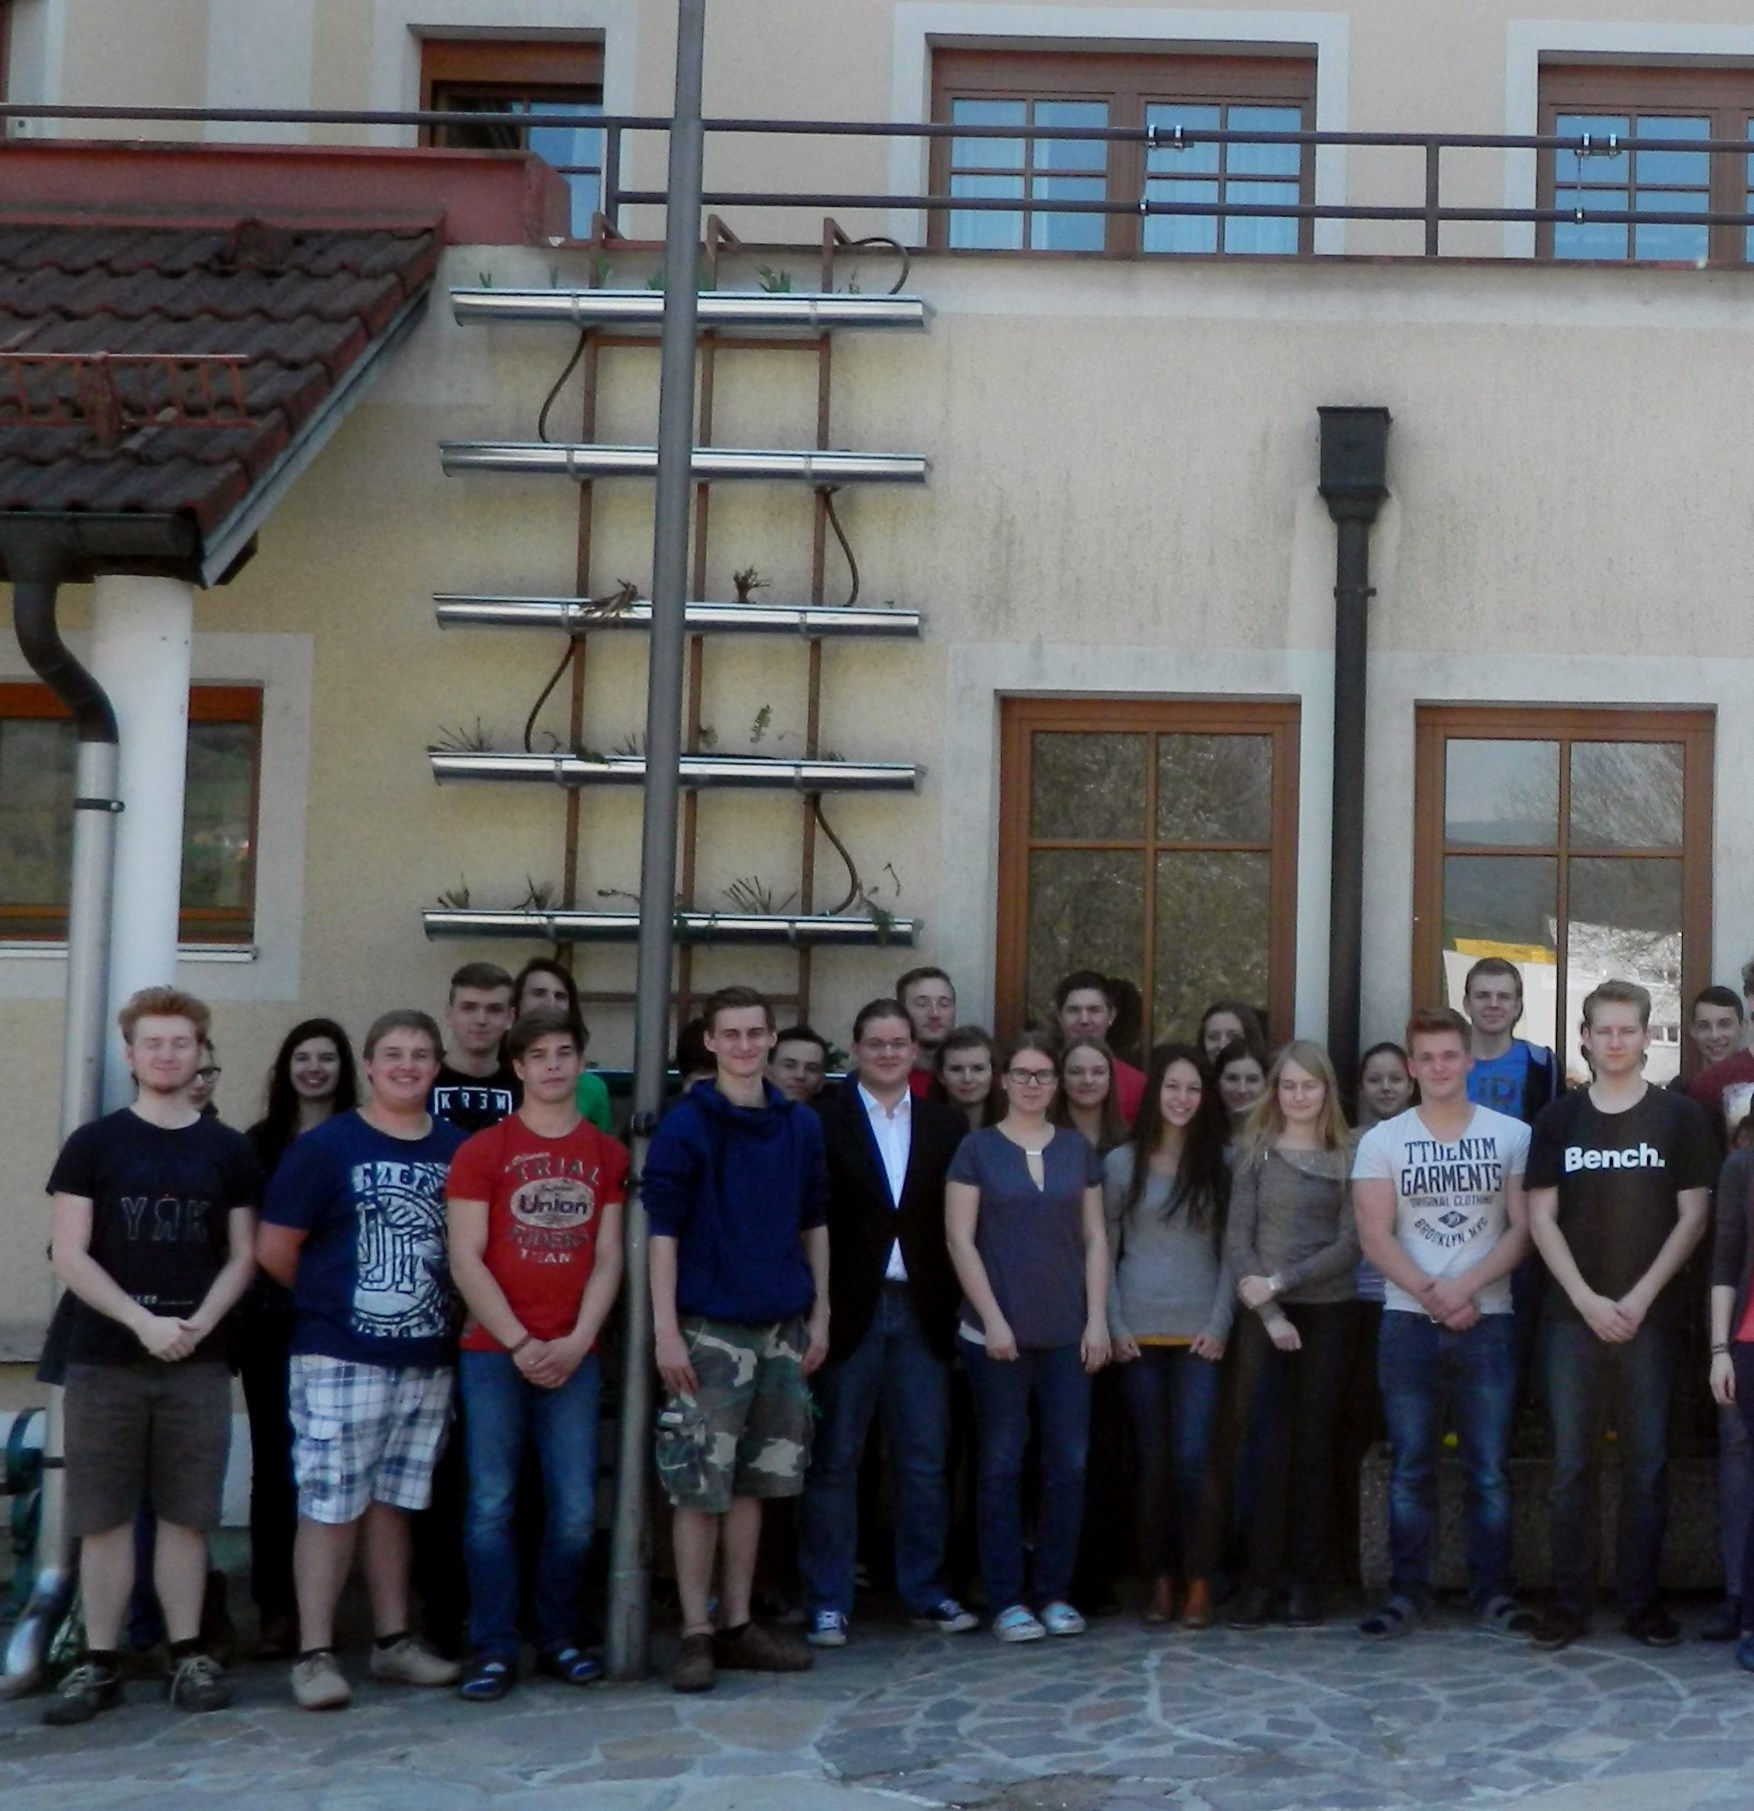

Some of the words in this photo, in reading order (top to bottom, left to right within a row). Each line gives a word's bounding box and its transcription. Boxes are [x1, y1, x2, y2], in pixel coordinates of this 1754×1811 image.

[1564, 1142, 1666, 1173] Bench.
[1401, 1163, 1503, 1197] GARMENTS
[519, 1194, 589, 1216] Union
[1414, 1218, 1466, 1248] BROOKLYN
